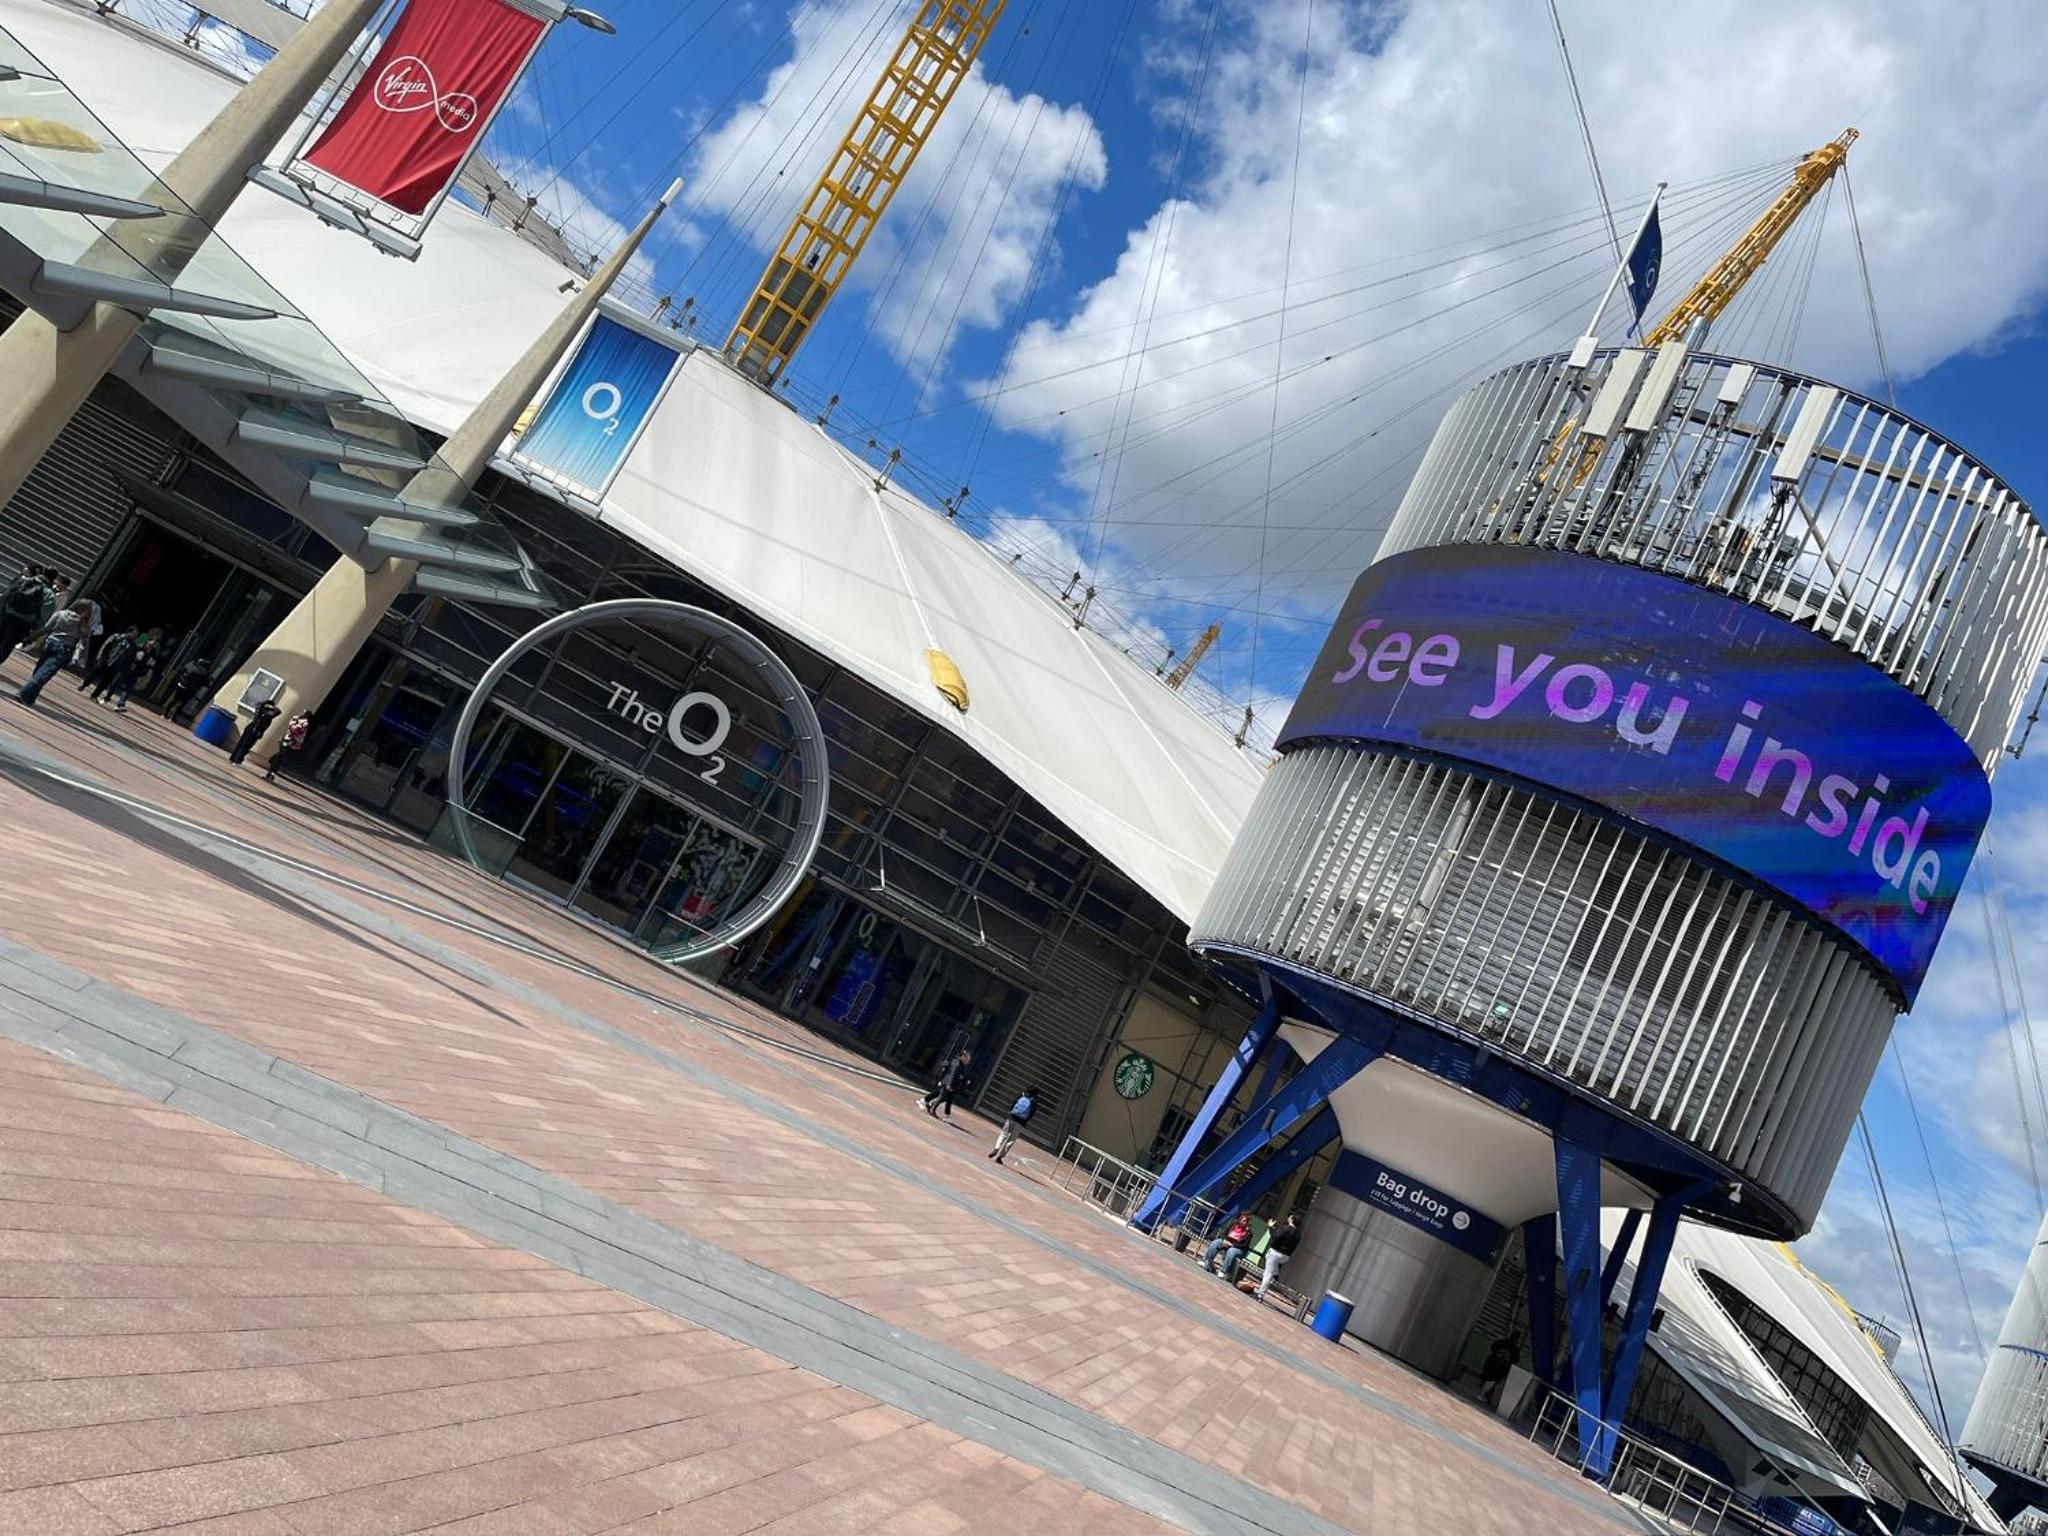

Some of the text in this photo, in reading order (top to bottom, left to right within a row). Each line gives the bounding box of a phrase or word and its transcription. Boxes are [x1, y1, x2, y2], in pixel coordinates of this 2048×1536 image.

[385, 66, 427, 104] Virgin
[440, 101, 470, 121] media
[607, 681, 663, 733] The
[1333, 619, 1941, 914] See you inside
[1376, 1171, 1407, 1198] Bag
[1410, 1189, 1448, 1218] drop
